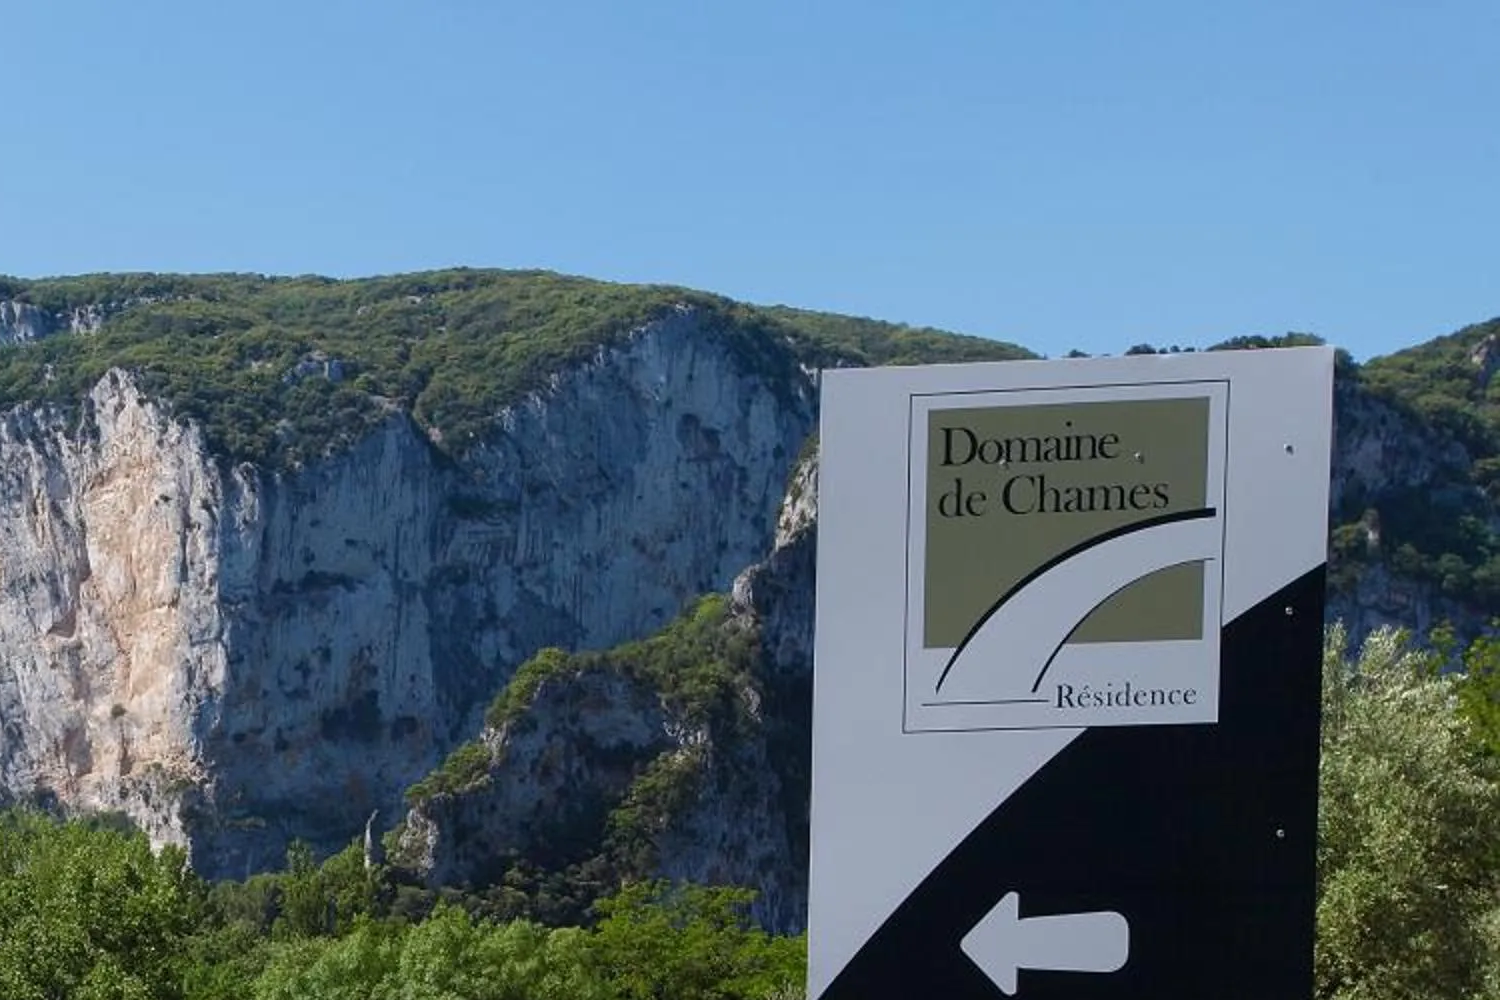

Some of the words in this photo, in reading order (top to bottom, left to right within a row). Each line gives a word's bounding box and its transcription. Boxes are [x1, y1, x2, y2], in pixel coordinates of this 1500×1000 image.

[939, 421, 1120, 467] Domaine
[938, 477, 987, 518] de
[1001, 473, 1170, 515] Chames
[1055, 682, 1198, 709] Résidence
